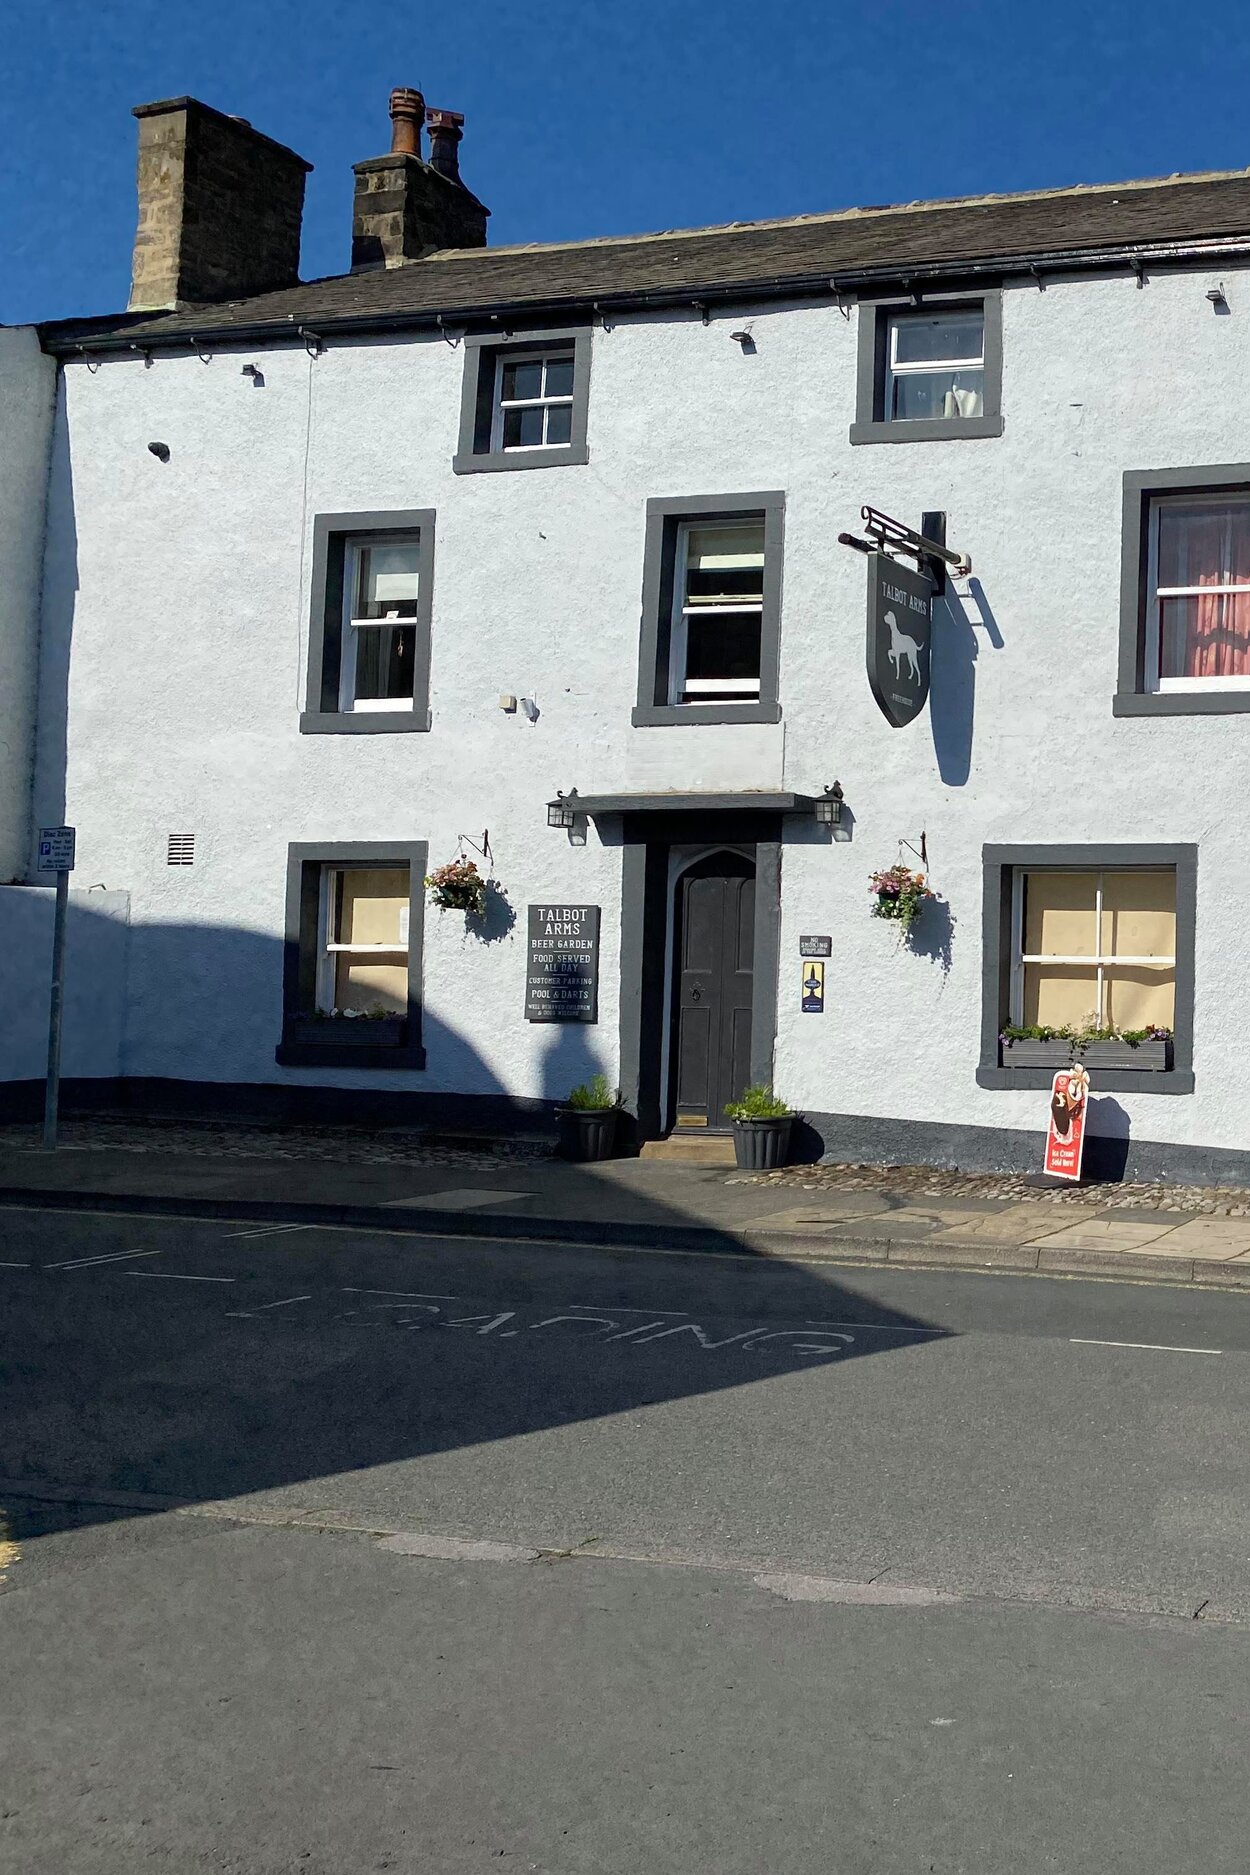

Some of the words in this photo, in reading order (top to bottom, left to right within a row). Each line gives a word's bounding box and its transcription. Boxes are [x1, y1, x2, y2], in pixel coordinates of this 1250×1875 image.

[882, 581, 907, 607] TALBOT
[908, 595, 927, 616] ARMS
[538, 909, 588, 921] TALBOT
[544, 923, 581, 935] ARMS
[531, 940, 554, 949] BEER
[557, 940, 593, 949] GARDEN
[533, 954, 554, 963] FOOD
[557, 954, 591, 964] SERVED
[544, 963, 558, 972] ALL
[561, 964, 578, 972] DAY
[528, 977, 561, 985] CUSTOMER
[563, 977, 593, 985] PARKING
[531, 989, 551, 999] POOL
[553, 990, 560, 999] &
[561, 990, 589, 999] DARTS
